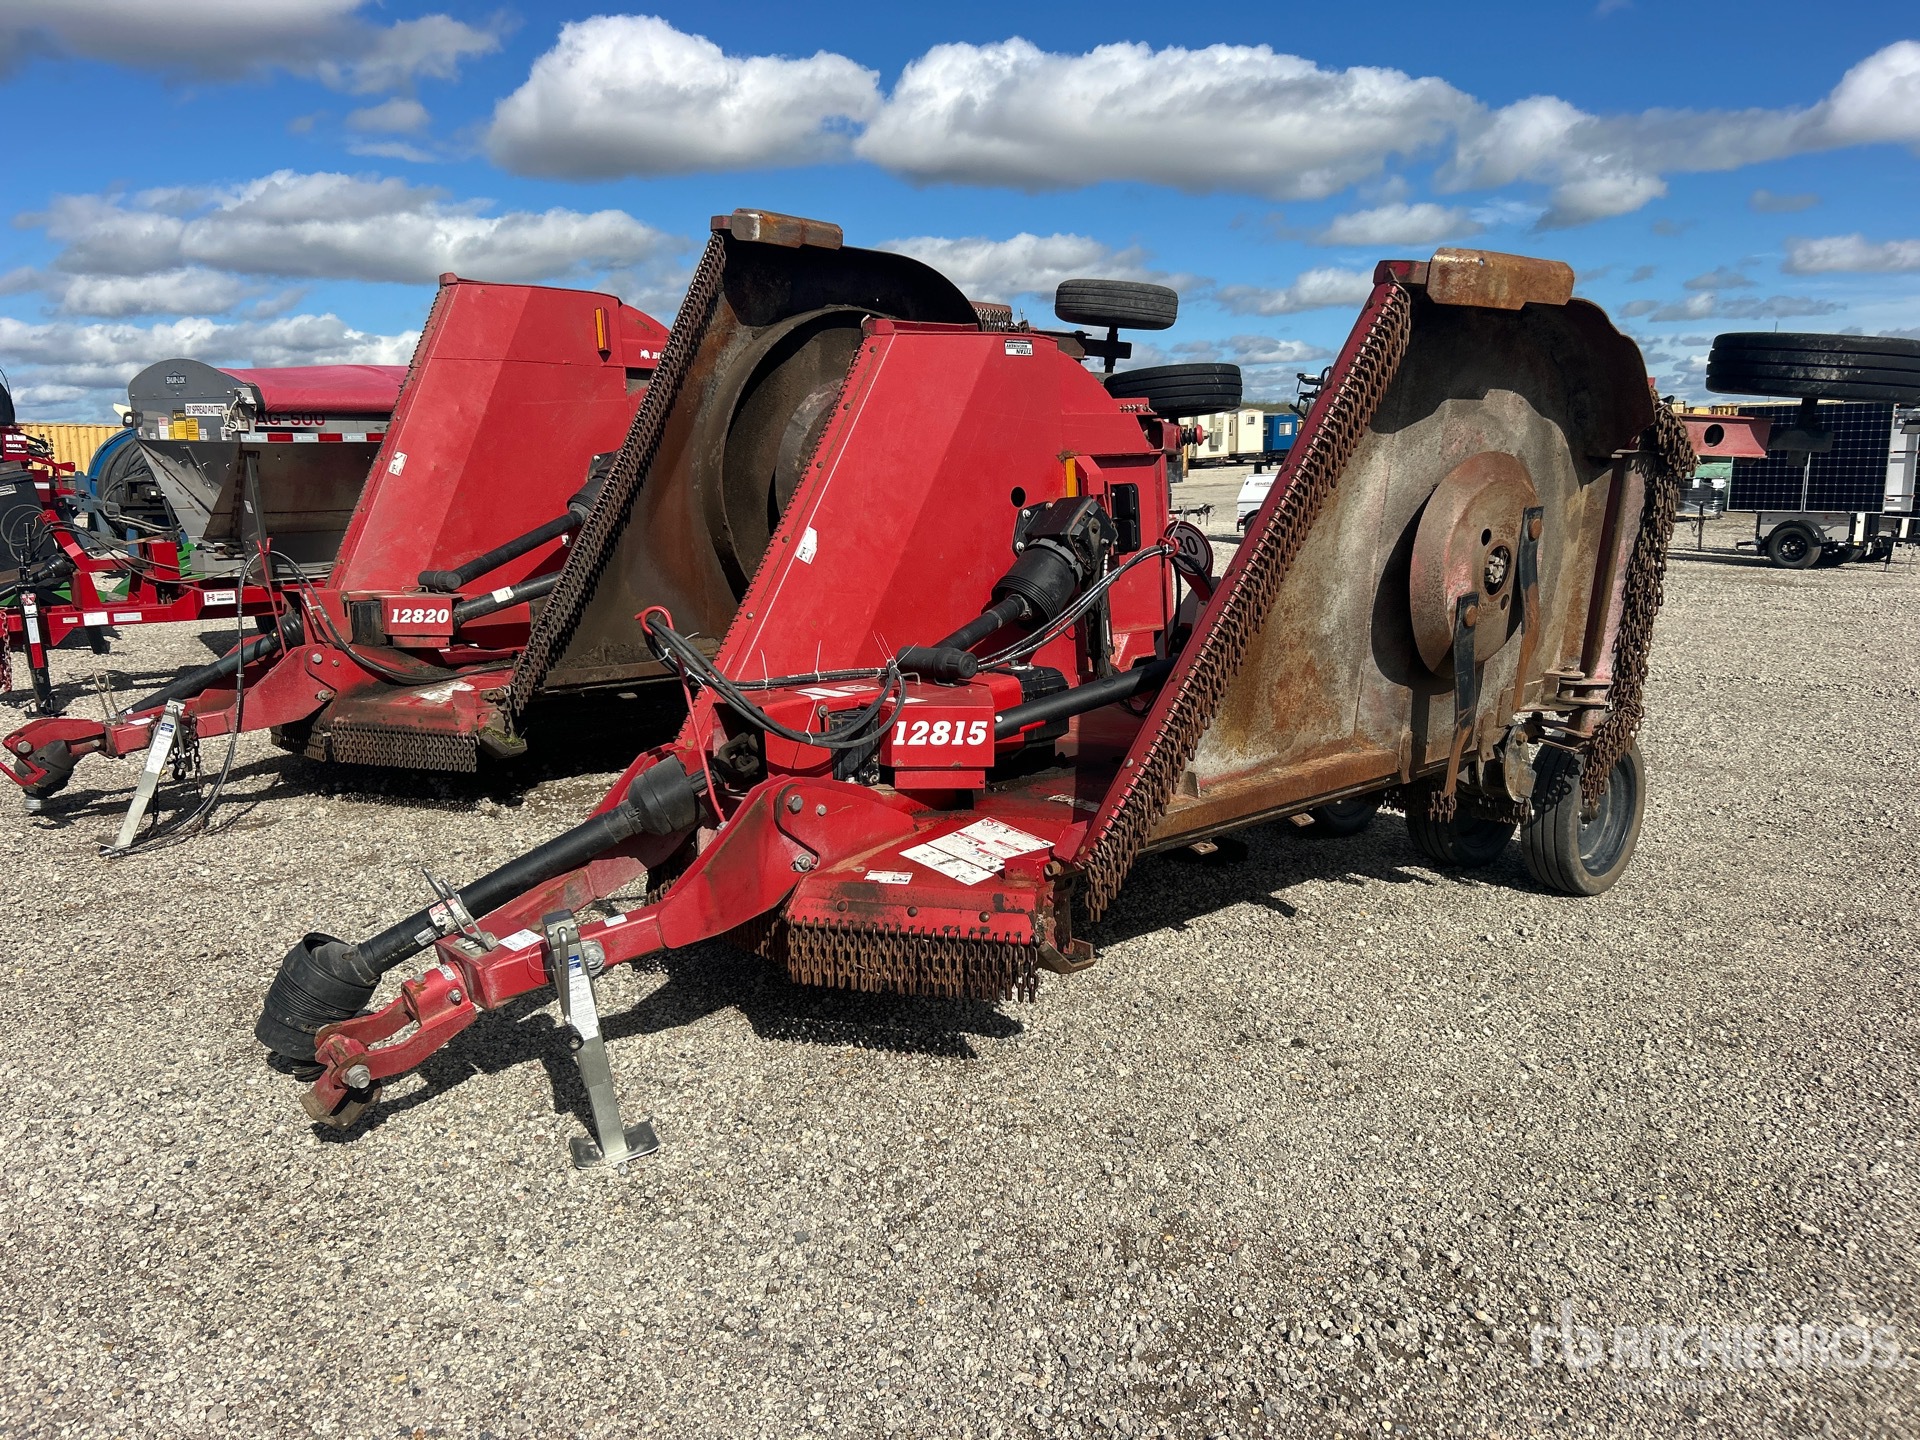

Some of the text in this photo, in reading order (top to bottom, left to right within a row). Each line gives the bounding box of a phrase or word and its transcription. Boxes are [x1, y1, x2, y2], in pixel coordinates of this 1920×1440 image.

[192, 405, 207, 414] SPREAD
[208, 405, 225, 414] PATTER
[255, 413, 326, 426] AG-500
[391, 608, 450, 623] 12820
[892, 720, 989, 746] 12815
